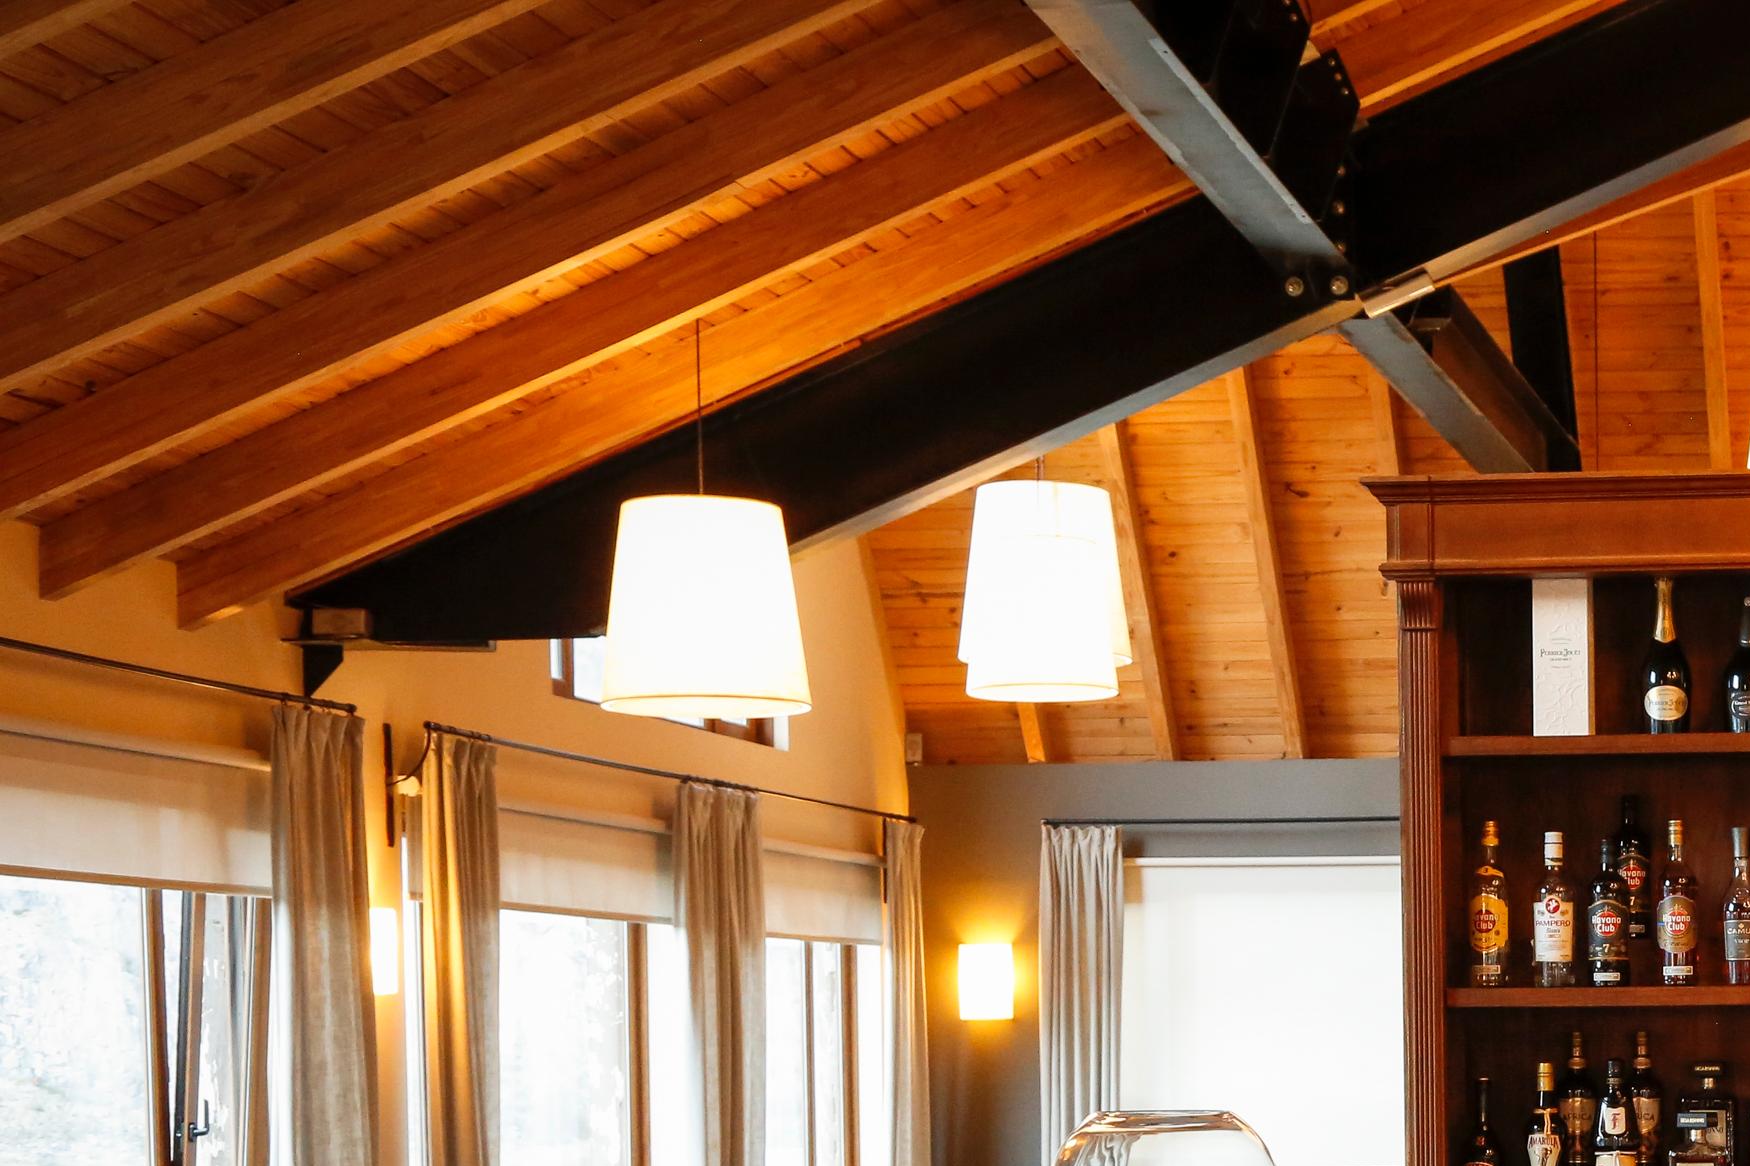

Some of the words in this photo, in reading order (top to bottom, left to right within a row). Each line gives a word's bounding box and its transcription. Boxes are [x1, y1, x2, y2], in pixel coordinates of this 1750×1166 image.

[1596, 924, 1615, 932] Club
[1668, 922, 1686, 930] Club
[1602, 944, 1610, 952] 7
